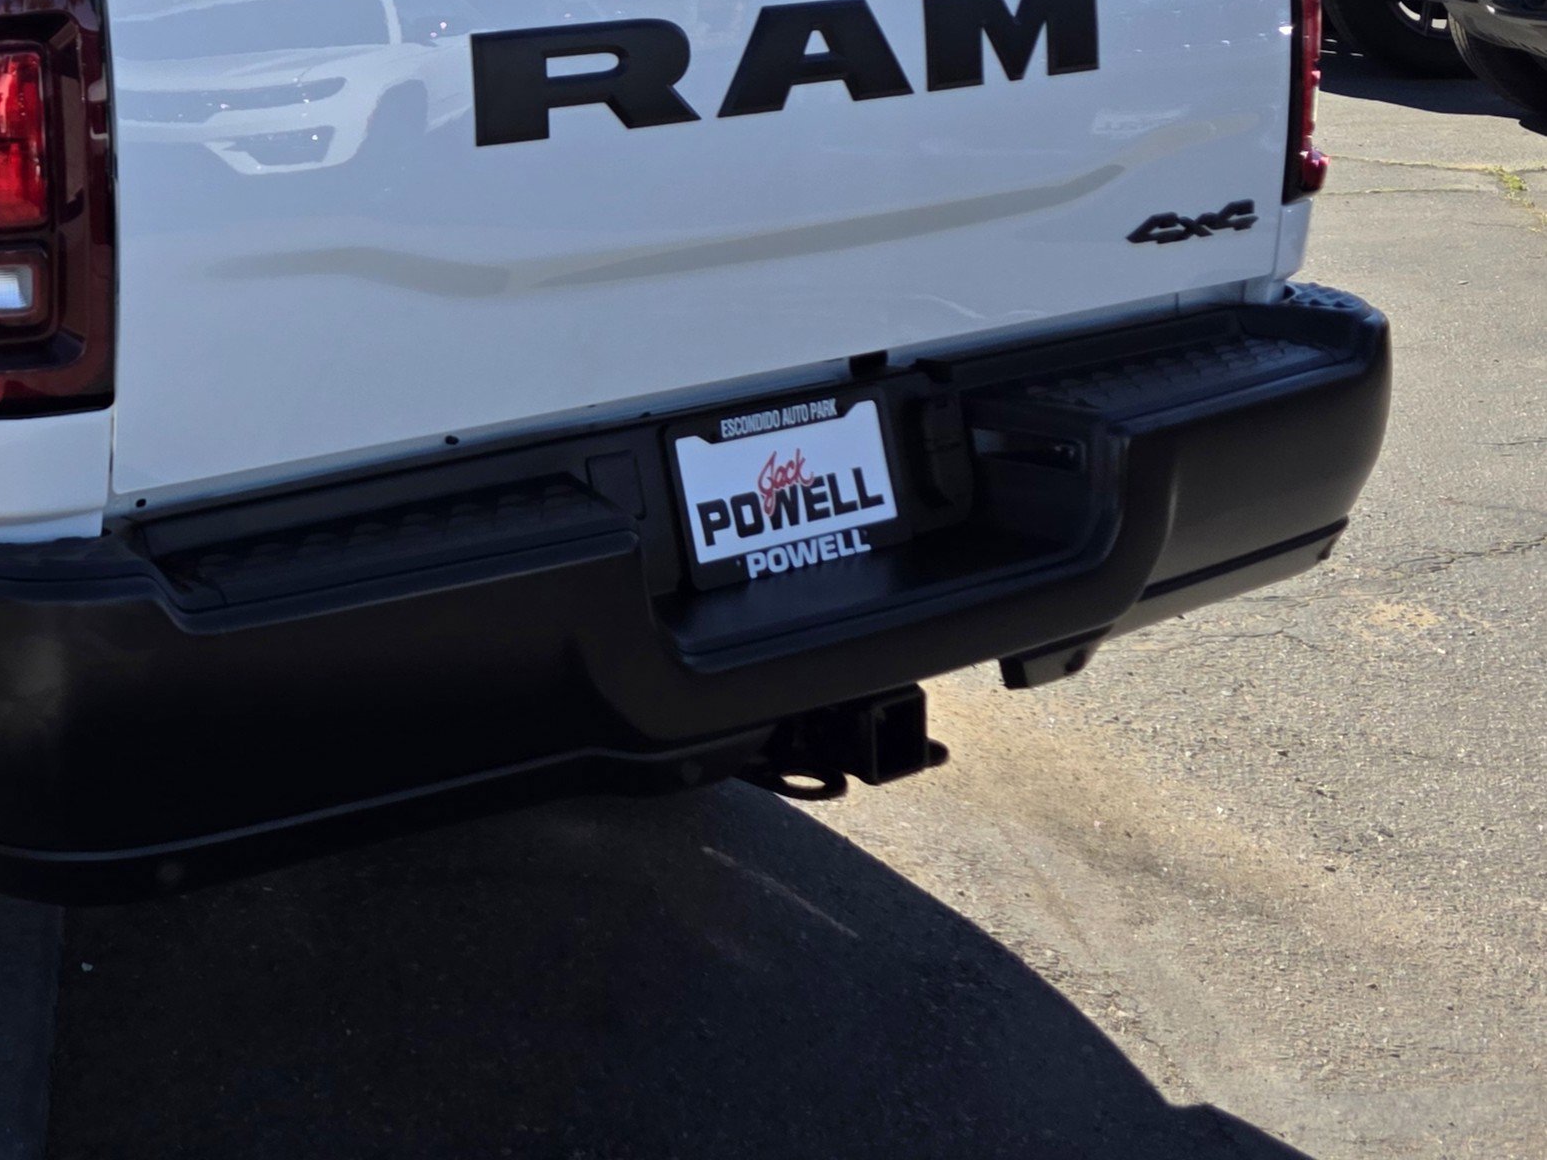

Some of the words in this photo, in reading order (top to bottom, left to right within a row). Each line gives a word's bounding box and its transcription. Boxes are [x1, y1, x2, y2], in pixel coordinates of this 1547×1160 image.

[720, 409, 780, 439] ESCONDIDO
[782, 403, 809, 426] AUTO
[809, 398, 838, 420] PARK
[696, 467, 885, 547] POWELL
[757, 448, 814, 516] Jack
[746, 528, 872, 579] POWELL
